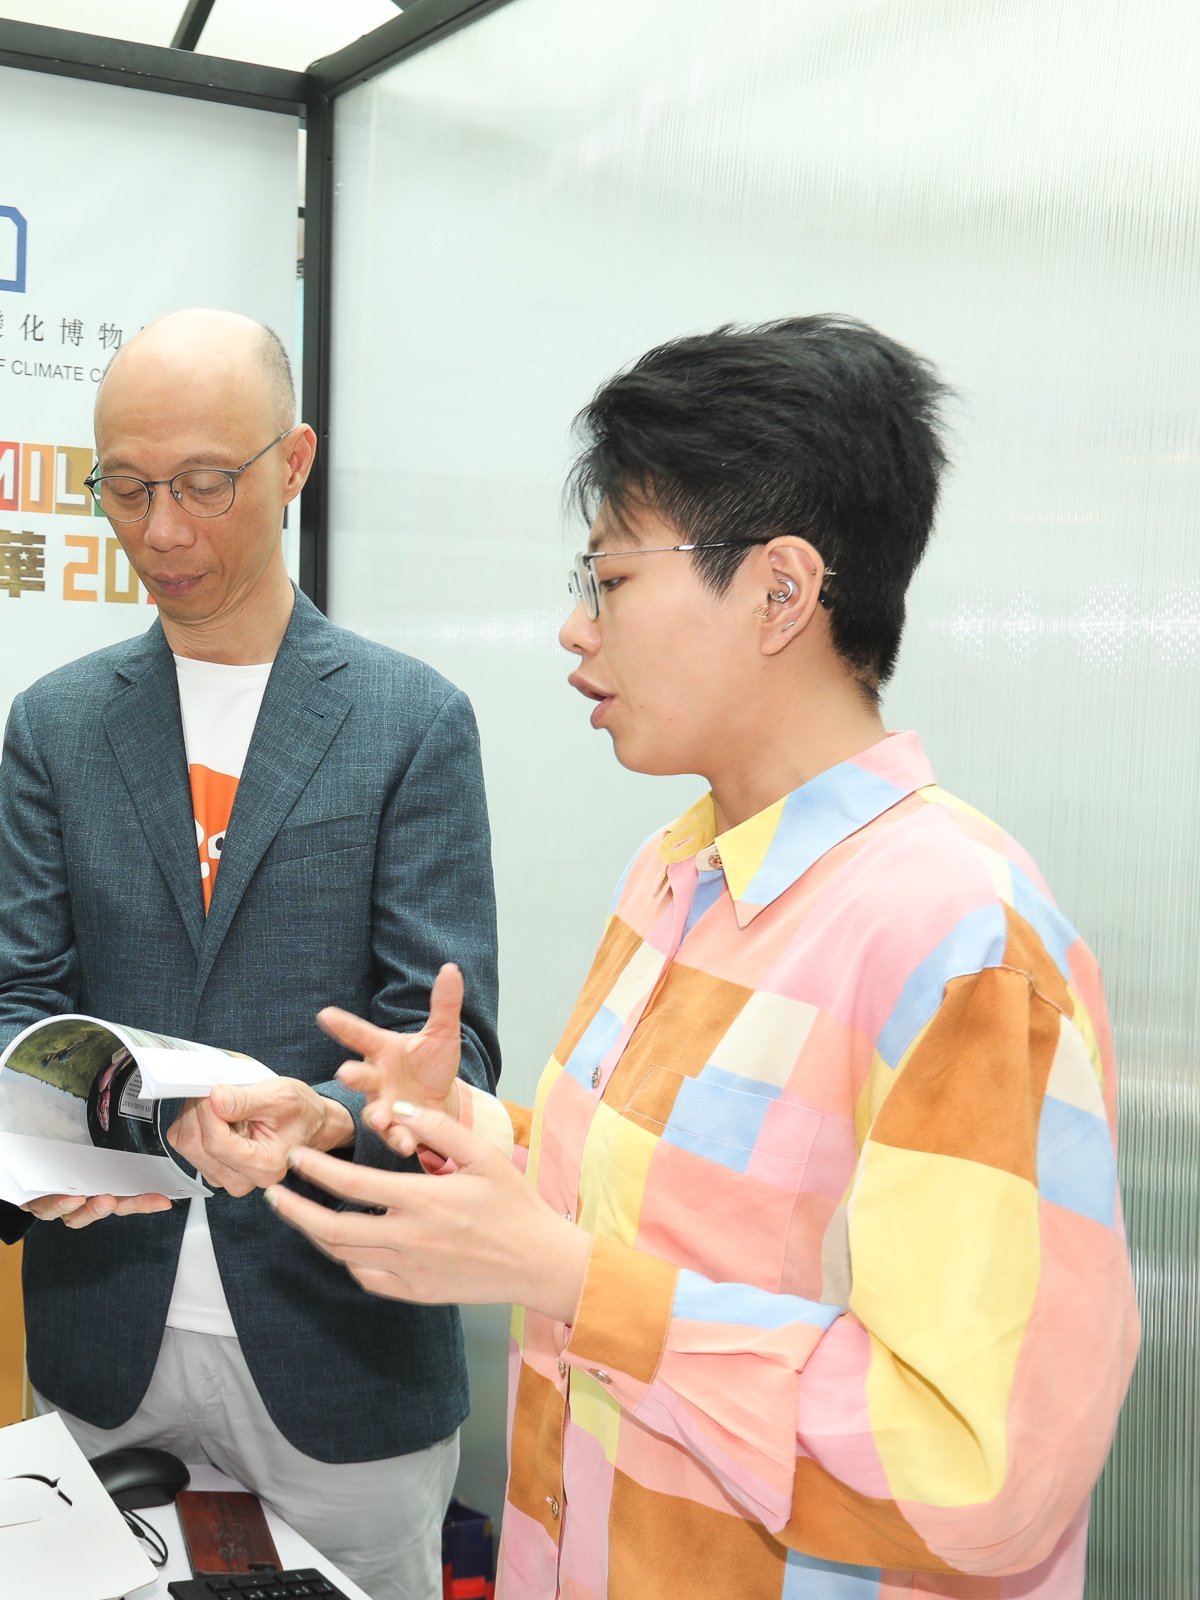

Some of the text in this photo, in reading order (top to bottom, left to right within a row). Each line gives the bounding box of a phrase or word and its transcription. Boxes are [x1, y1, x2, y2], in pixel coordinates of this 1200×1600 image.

[11, 360, 85, 381] CLIMATE
[89, 368, 105, 383] C
[63, 534, 156, 605] 20
